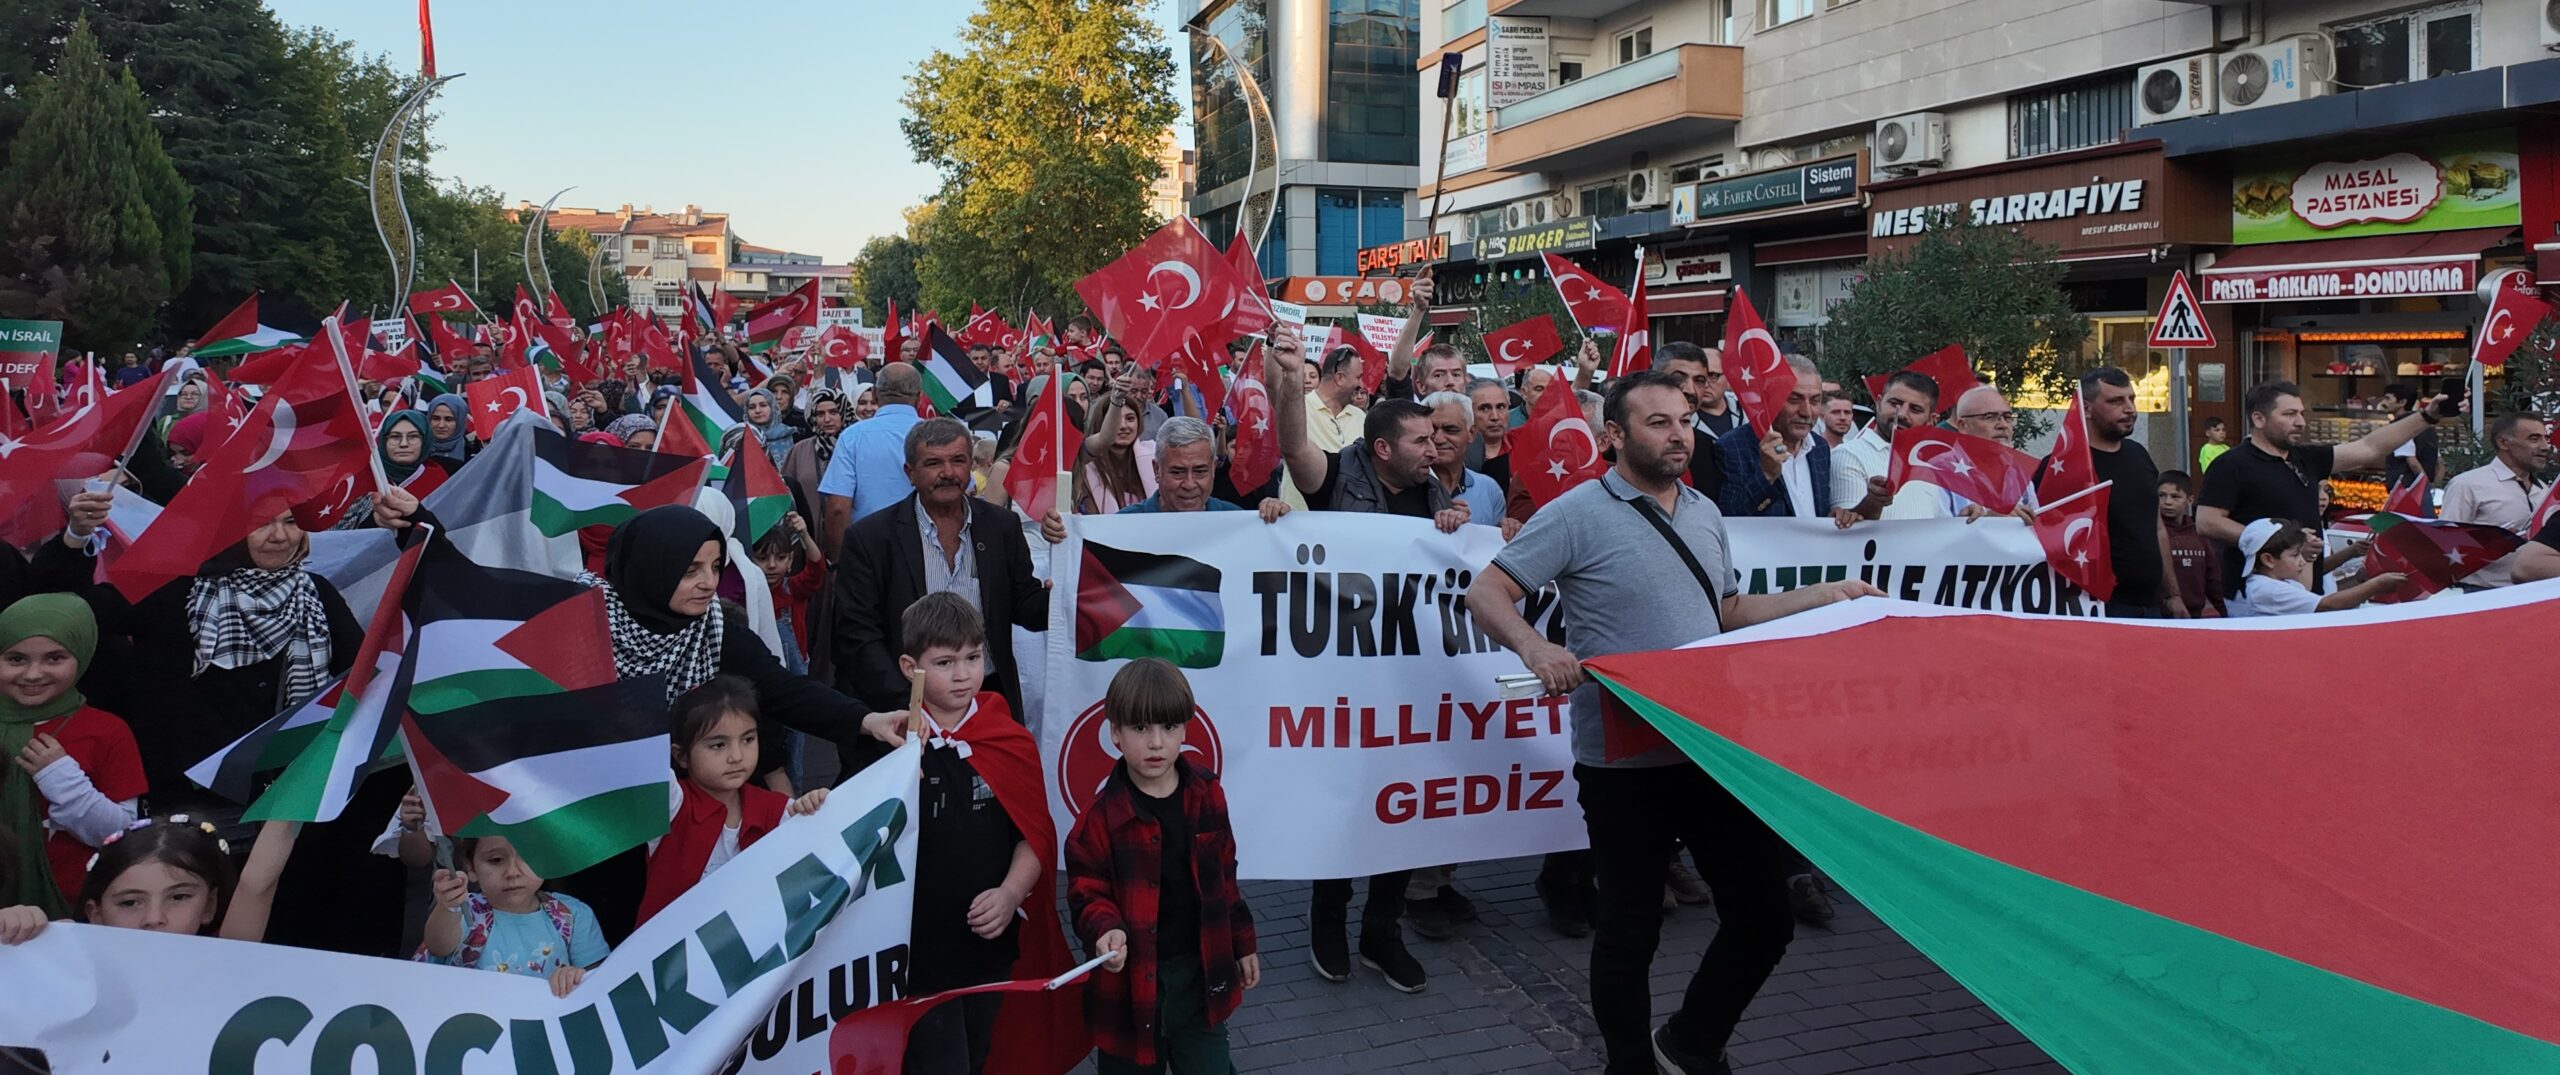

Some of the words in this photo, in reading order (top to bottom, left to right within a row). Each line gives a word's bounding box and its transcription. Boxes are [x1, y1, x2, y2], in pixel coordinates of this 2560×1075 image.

[1512, 63, 1539, 71] uygulama
[2189, 60, 2201, 97] arçelik
[1809, 166, 1853, 185] Sistem
[2324, 168, 2399, 191] MASAL
[1969, 175, 2144, 228] SARRAFİYE
[1674, 215, 1693, 223] ADEL
[1507, 228, 1566, 254] BURGER
[2081, 225, 2108, 236] MESUT
[11, 328, 54, 343] İSRAİL
[1375, 763, 1565, 825] GEDİZ
